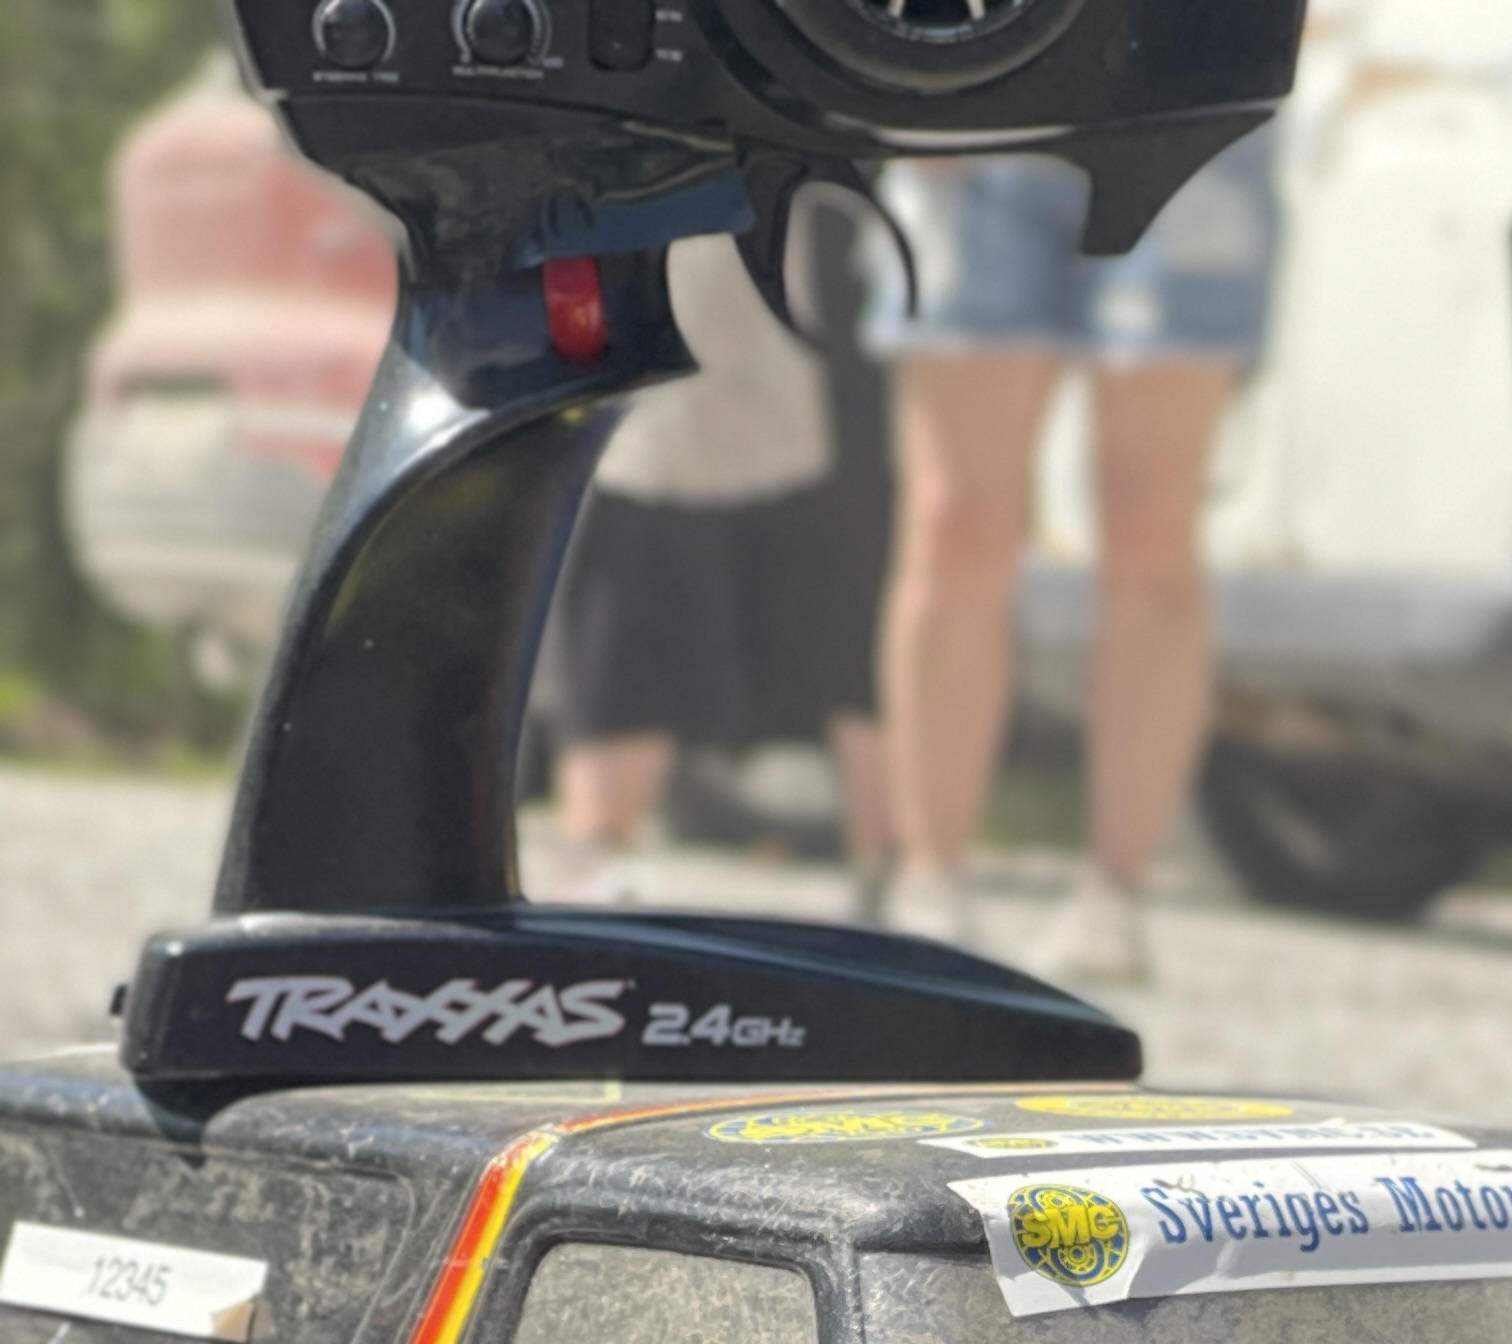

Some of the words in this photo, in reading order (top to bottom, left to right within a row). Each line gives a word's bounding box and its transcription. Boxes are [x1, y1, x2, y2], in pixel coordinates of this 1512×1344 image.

[226, 975, 628, 1047] TRAXXAS
[1022, 1206, 1120, 1250] SMC
[1140, 1181, 1370, 1253] Sveriges
[88, 1255, 173, 1307] 12345
